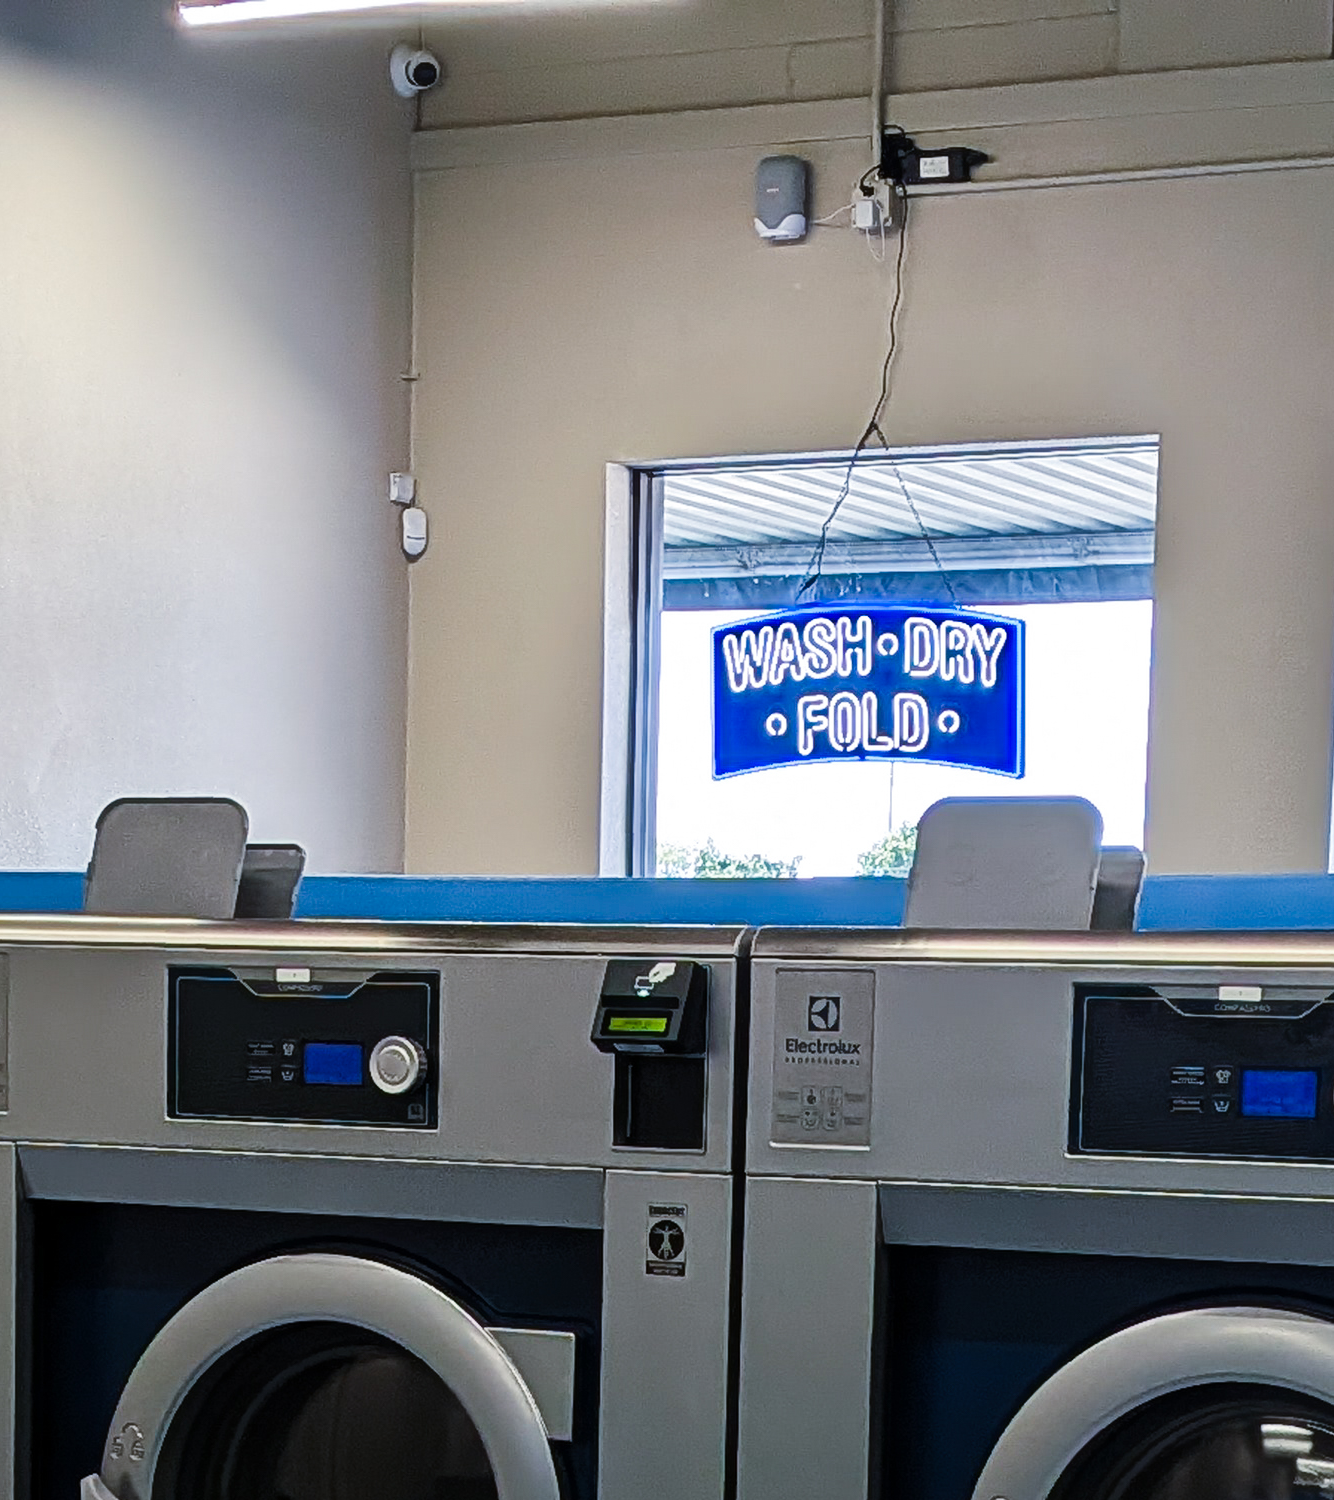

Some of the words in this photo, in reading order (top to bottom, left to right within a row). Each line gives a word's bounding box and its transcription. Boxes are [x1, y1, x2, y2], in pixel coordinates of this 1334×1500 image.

[722, 615, 873, 693] WASH
[903, 616, 1008, 688] DRY
[797, 691, 930, 756] FOLD
[785, 1038, 861, 1055] Electrolux
